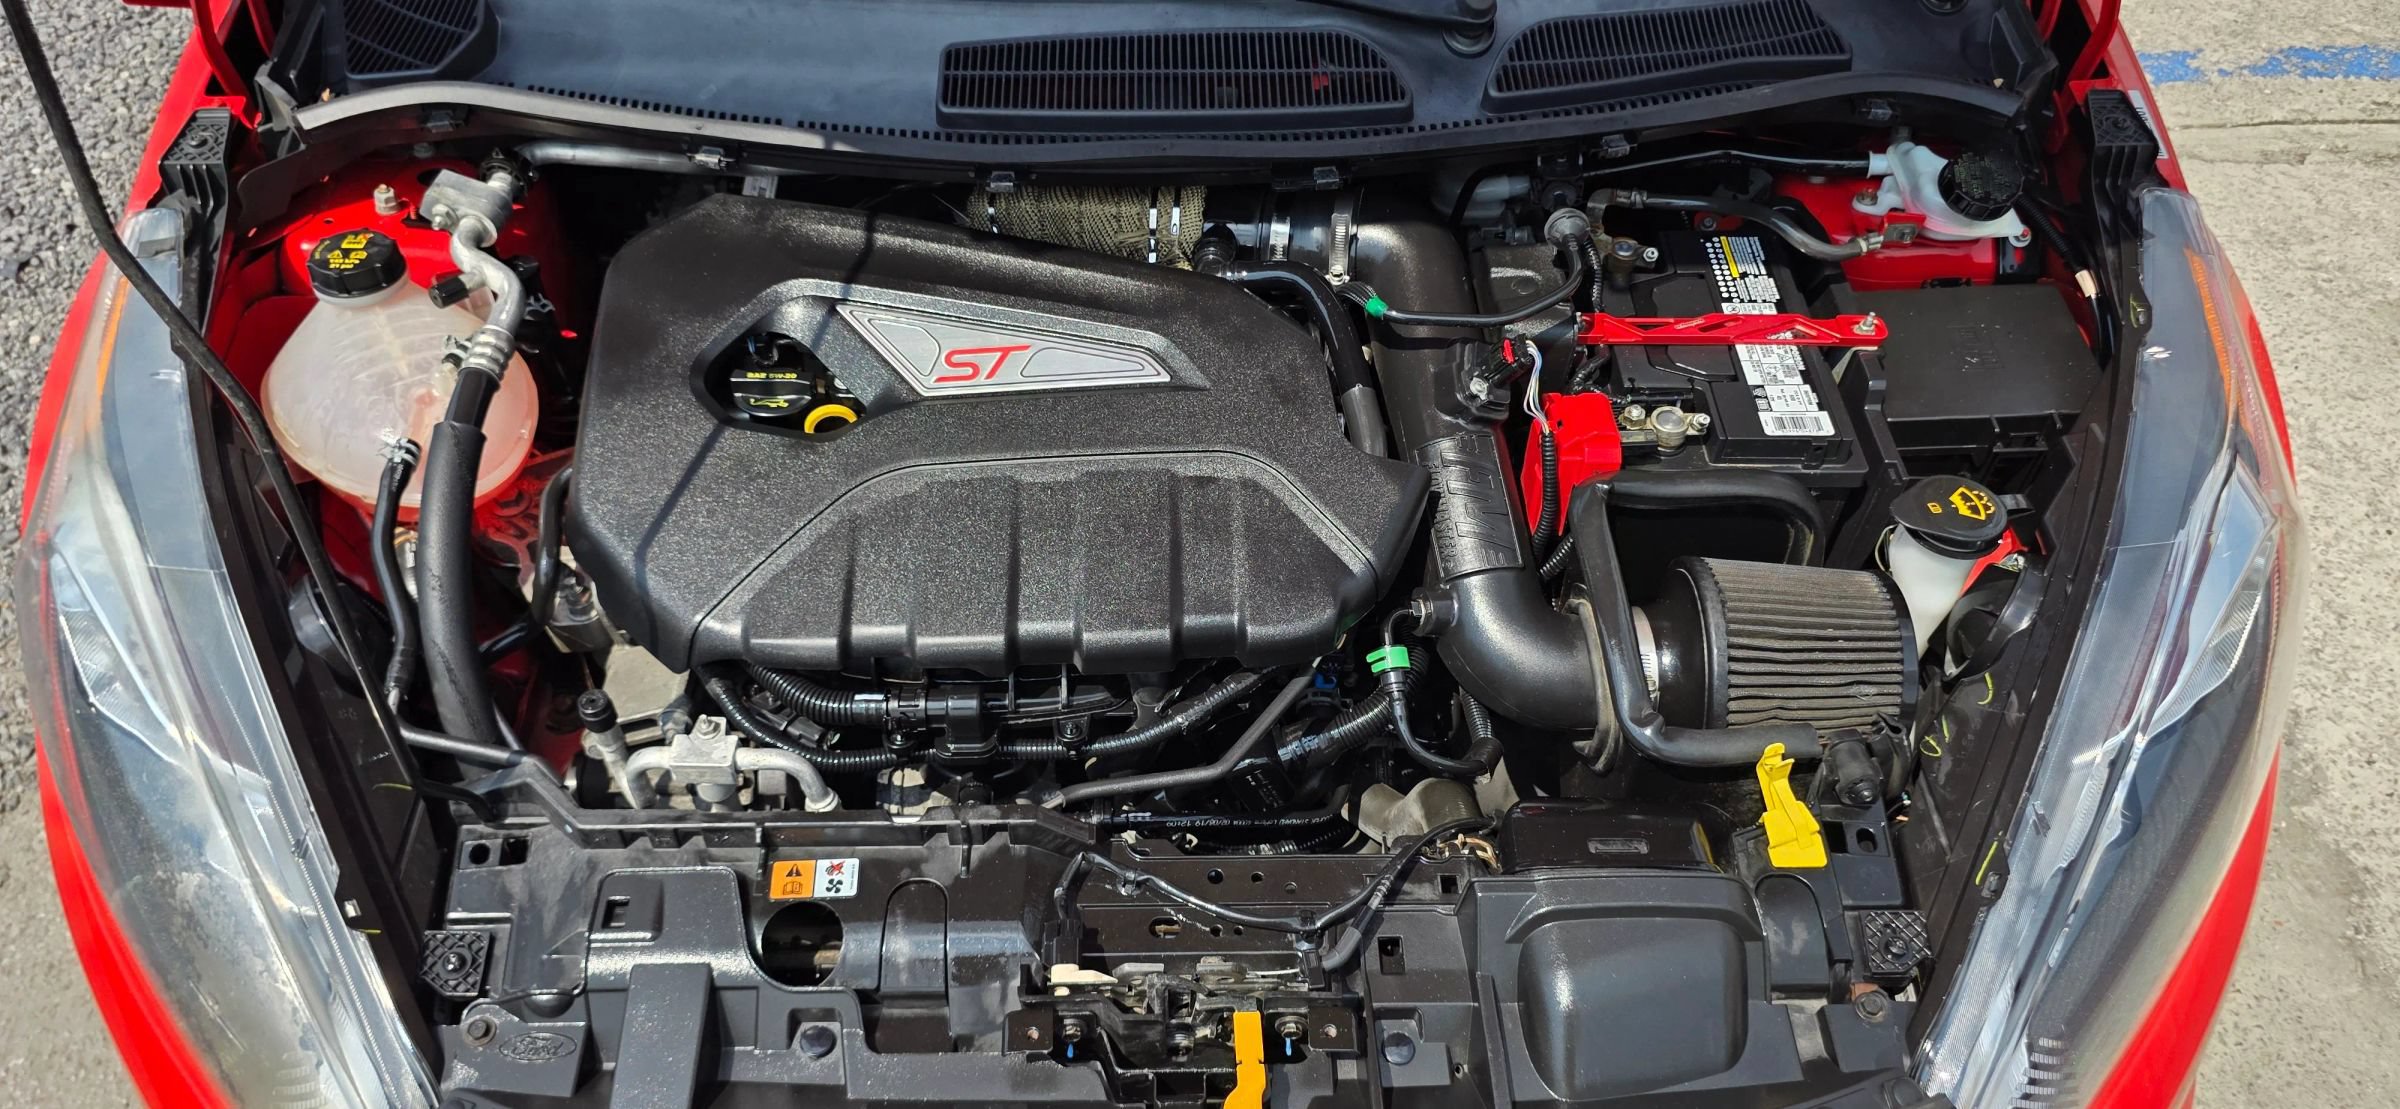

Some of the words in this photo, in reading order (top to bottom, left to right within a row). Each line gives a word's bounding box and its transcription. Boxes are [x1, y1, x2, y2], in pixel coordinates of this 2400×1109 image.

[746, 371, 767, 380] SAE
[768, 372, 798, 380] 5W-20
[933, 344, 1032, 384] ST
[511, 1035, 564, 1058] Ford
